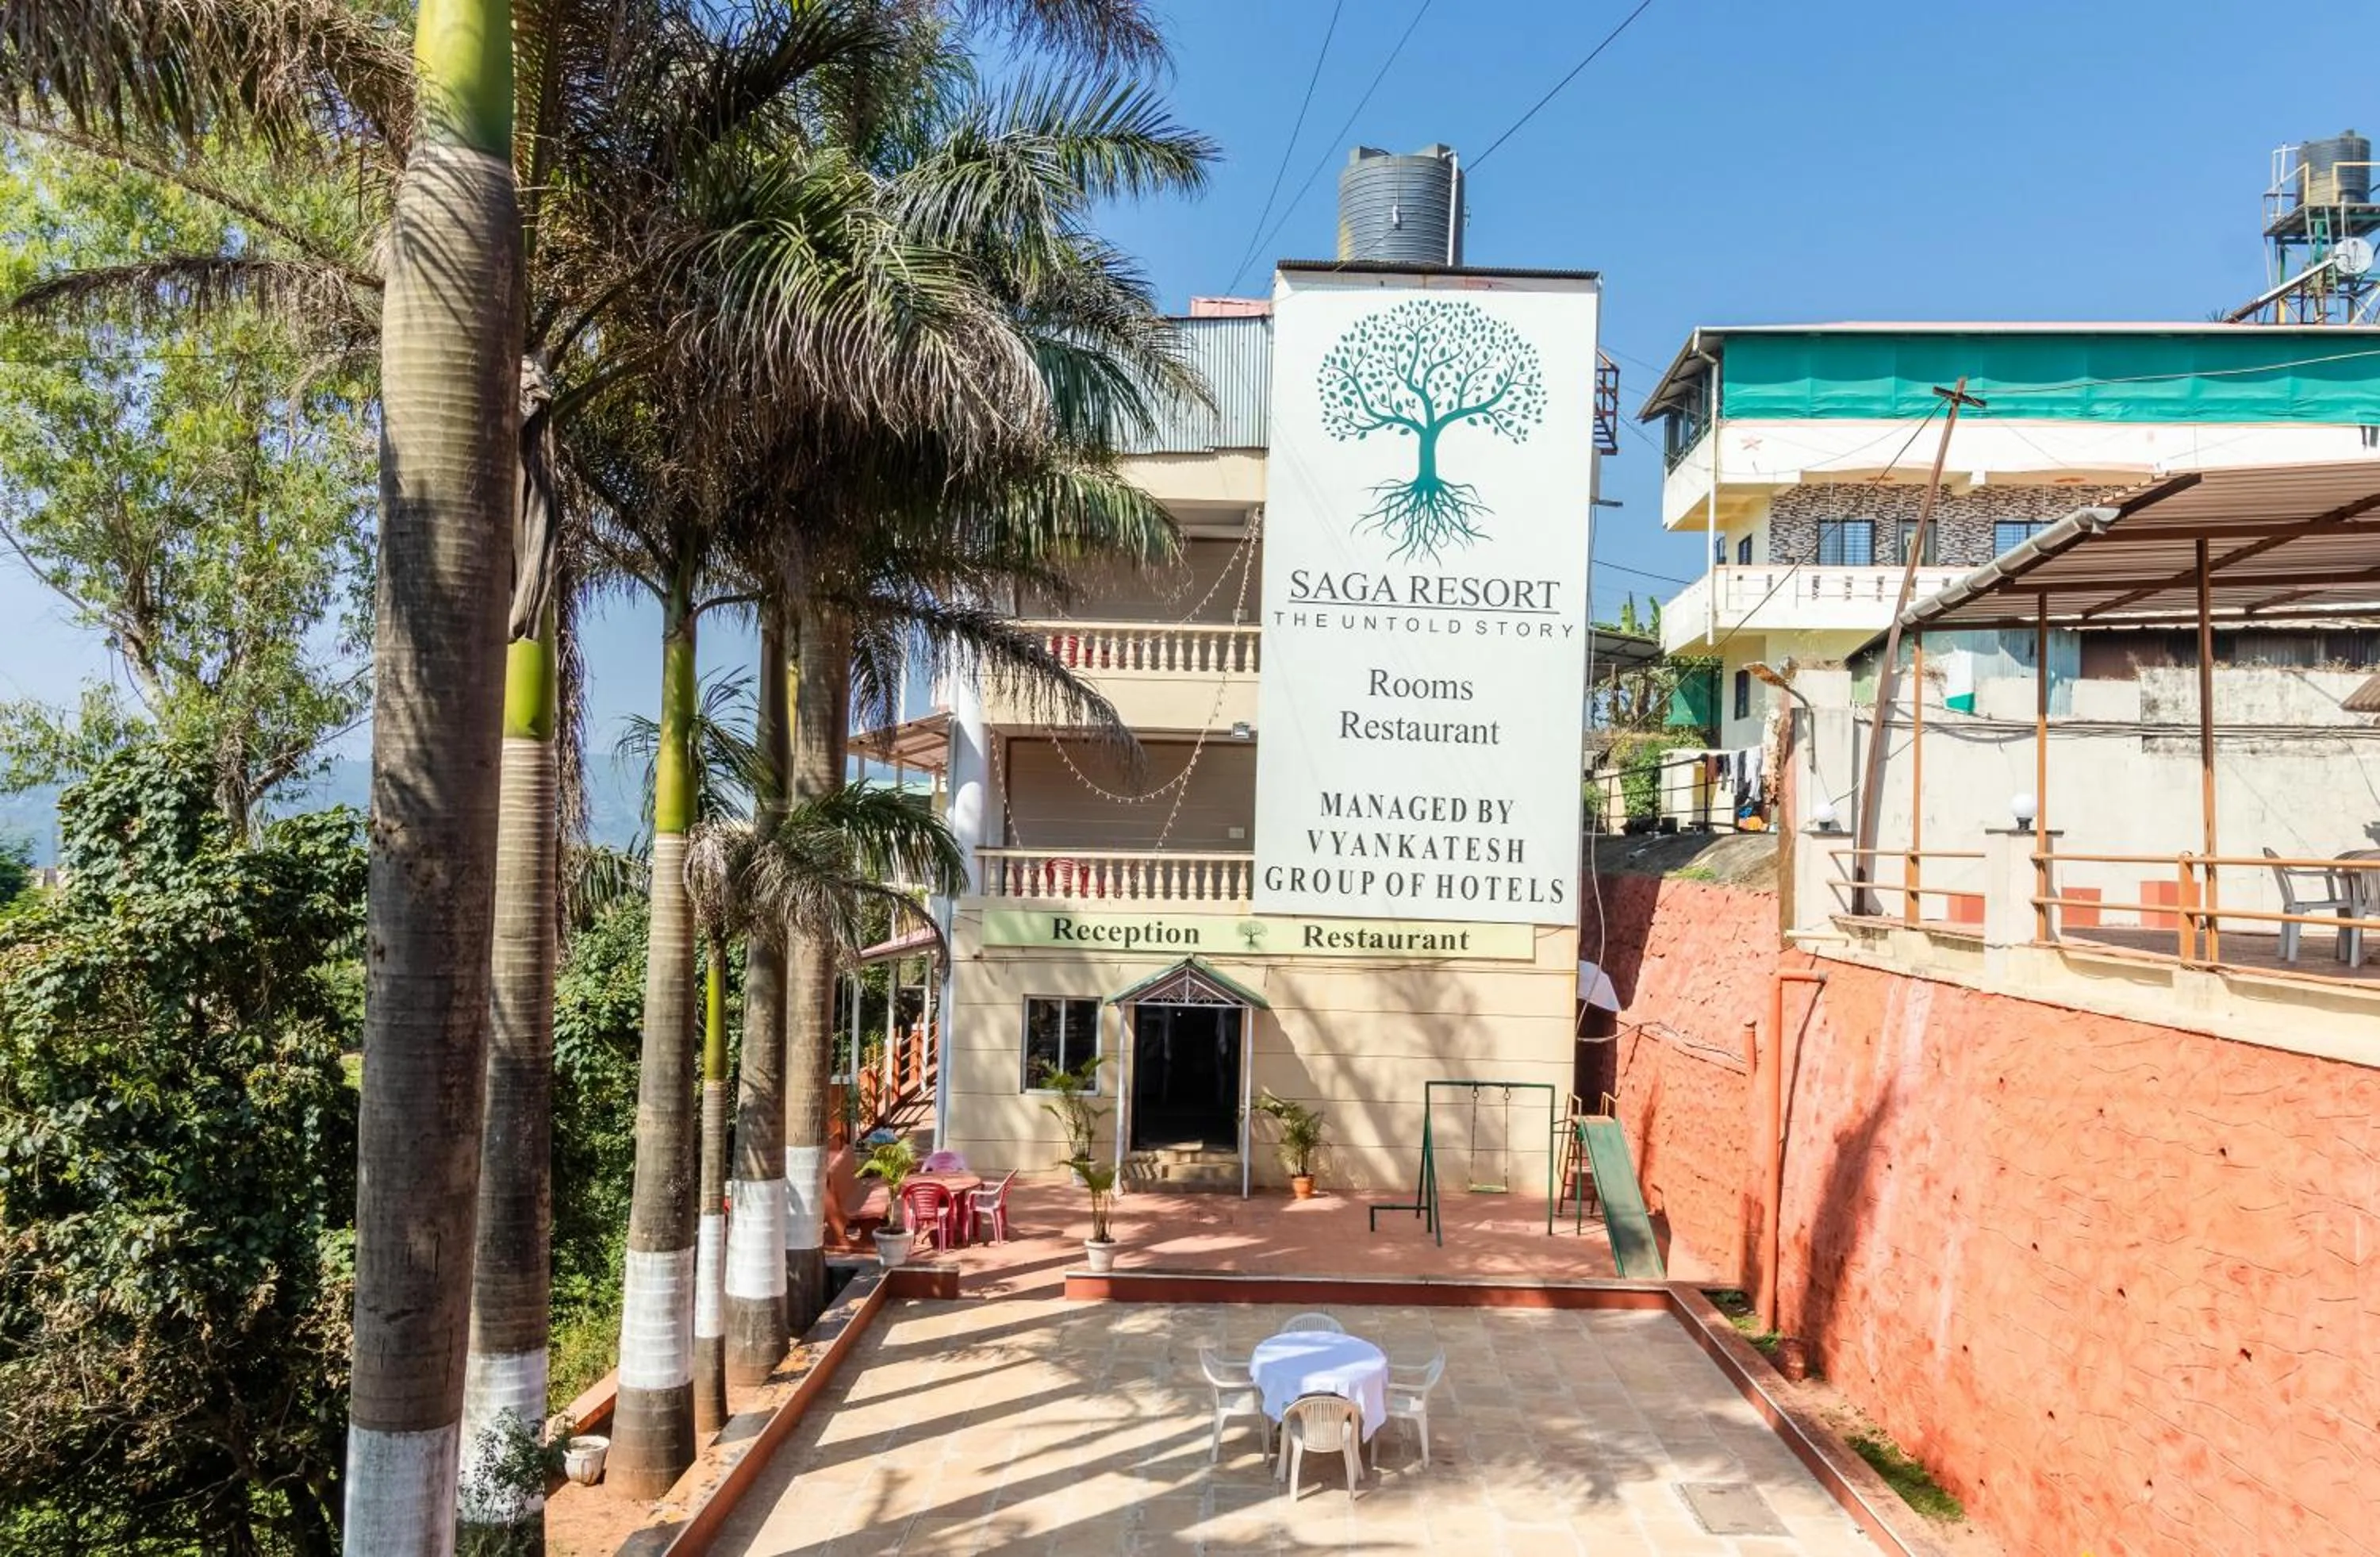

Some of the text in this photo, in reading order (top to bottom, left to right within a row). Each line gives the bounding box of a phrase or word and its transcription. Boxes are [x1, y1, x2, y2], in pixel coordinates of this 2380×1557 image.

[1290, 570, 1560, 609] SAGA RESORT
[1273, 611, 1574, 638] THE UNTOLD STORY
[1368, 669, 1473, 700] Rooms
[1338, 710, 1499, 744] Restaurant
[1320, 792, 1514, 825] MANAGED BY
[1307, 830, 1524, 863] VYANKATESH
[1265, 866, 1564, 903] GROUP OF HOTELS
[1051, 917, 1200, 948] Reception
[1303, 925, 1469, 950] Restaurant
